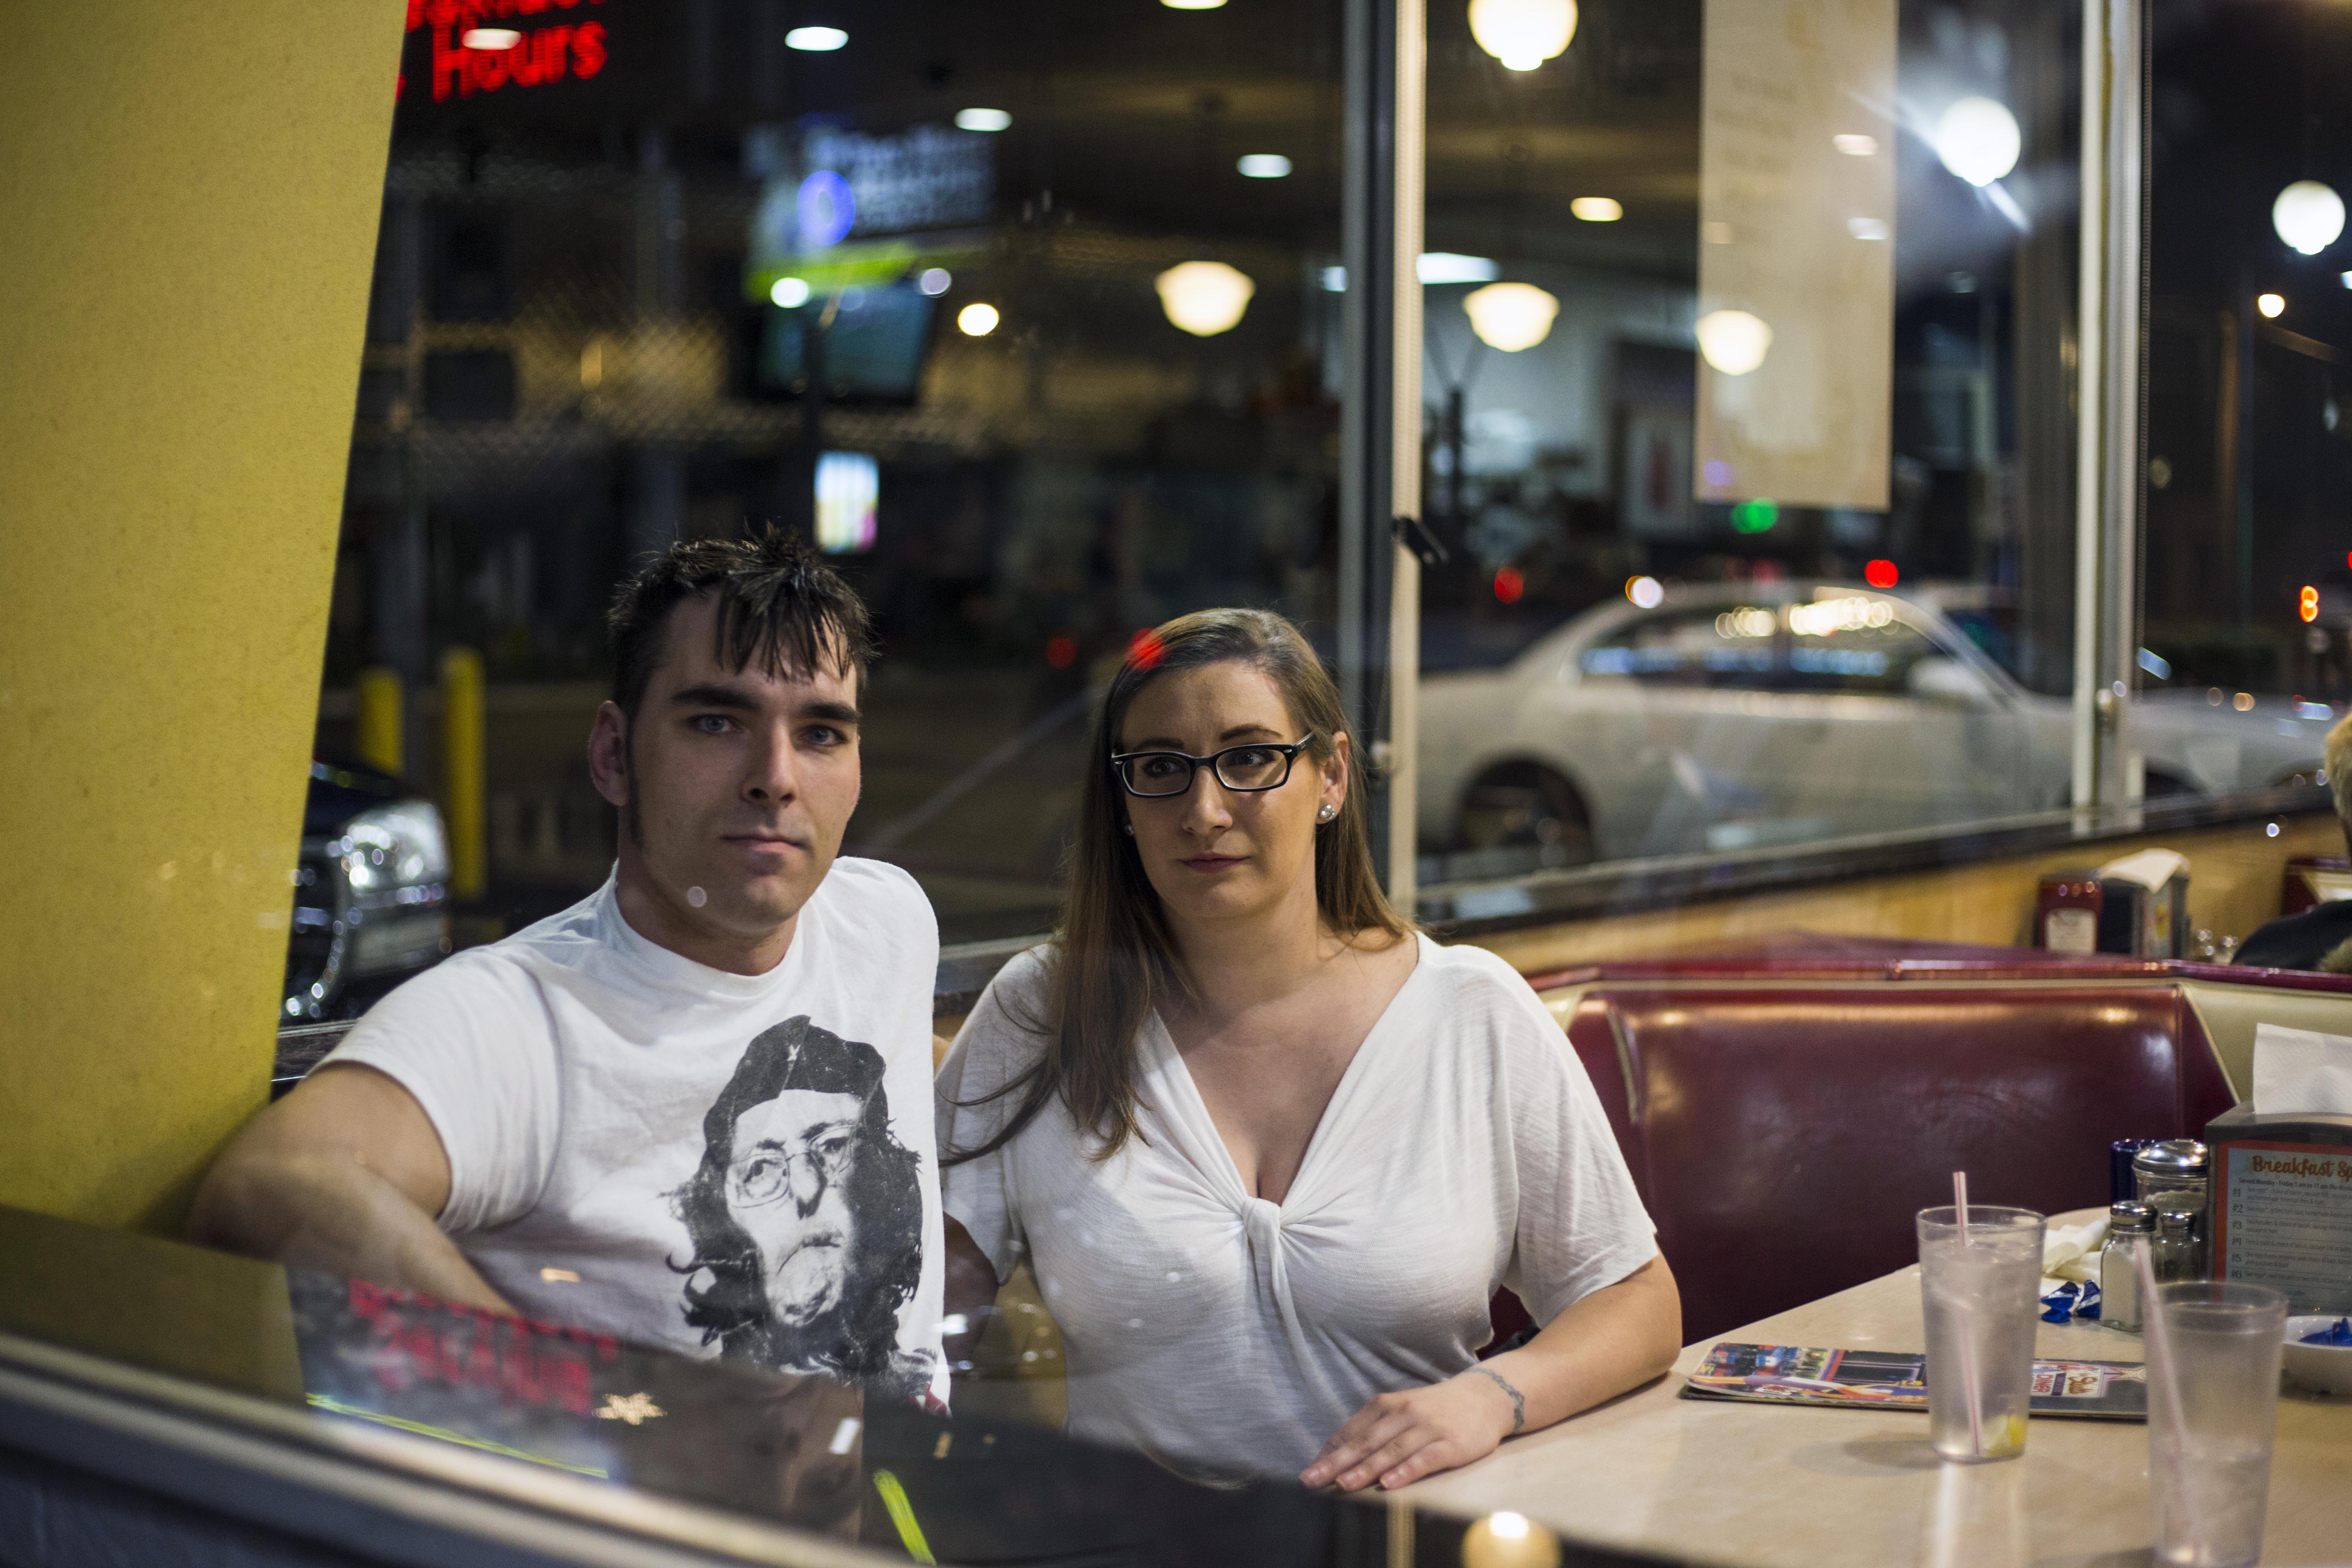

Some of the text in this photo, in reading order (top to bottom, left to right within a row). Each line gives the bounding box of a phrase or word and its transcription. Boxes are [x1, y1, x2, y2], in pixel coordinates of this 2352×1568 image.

[432, 18, 608, 103] Hours
[2252, 1155, 2334, 1177] Breakfast
[2233, 1188, 2241, 1197] #1
[2233, 1204, 2243, 1213] #2
[2232, 1220, 2242, 1230] #3
[2232, 1236, 2242, 1246] #4
[2231, 1253, 2242, 1263] #5
[2231, 1270, 2242, 1279] #6
[2032, 1374, 2054, 1393] DINER
